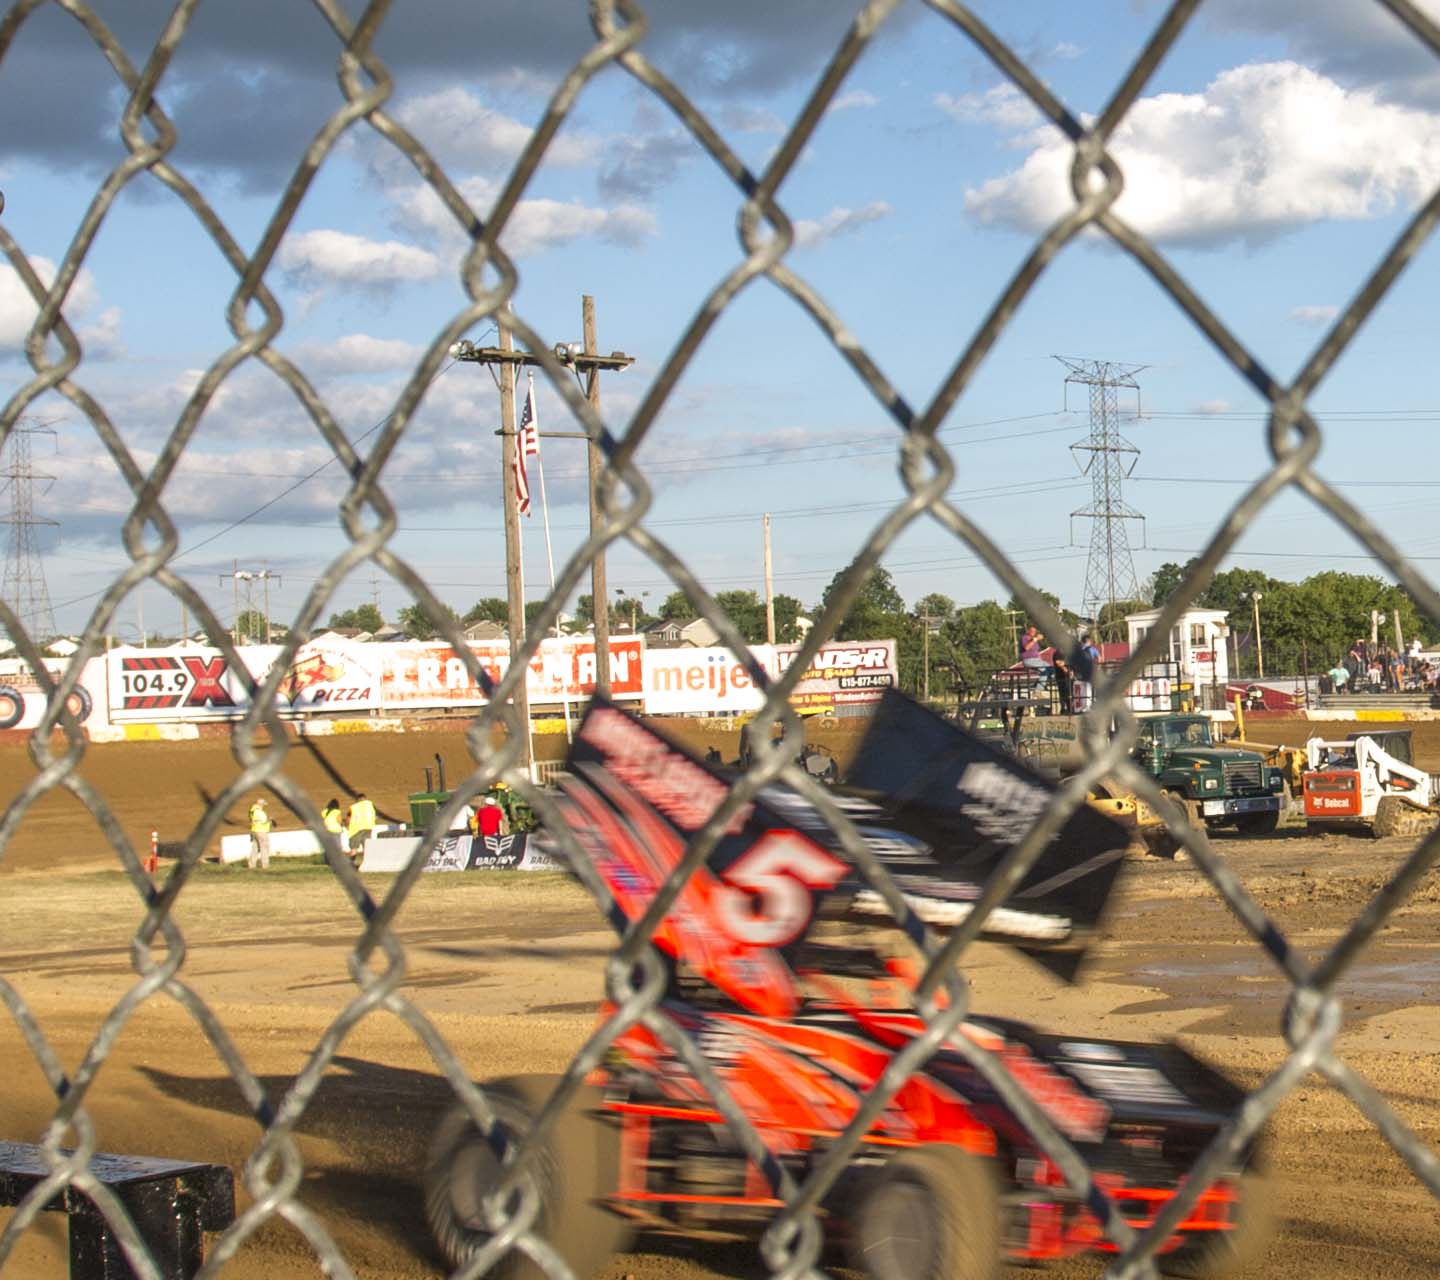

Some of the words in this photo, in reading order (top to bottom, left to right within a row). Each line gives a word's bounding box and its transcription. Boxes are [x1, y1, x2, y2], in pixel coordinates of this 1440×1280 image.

[392, 650, 629, 690] CRAFTMAN
[778, 648, 889, 671] WNDSOR
[122, 672, 188, 694] 104.9
[653, 655, 765, 698] meije
[312, 687, 372, 704] PIZZA
[1324, 798, 1350, 808] Bobcat
[708, 828, 852, 947] 5
